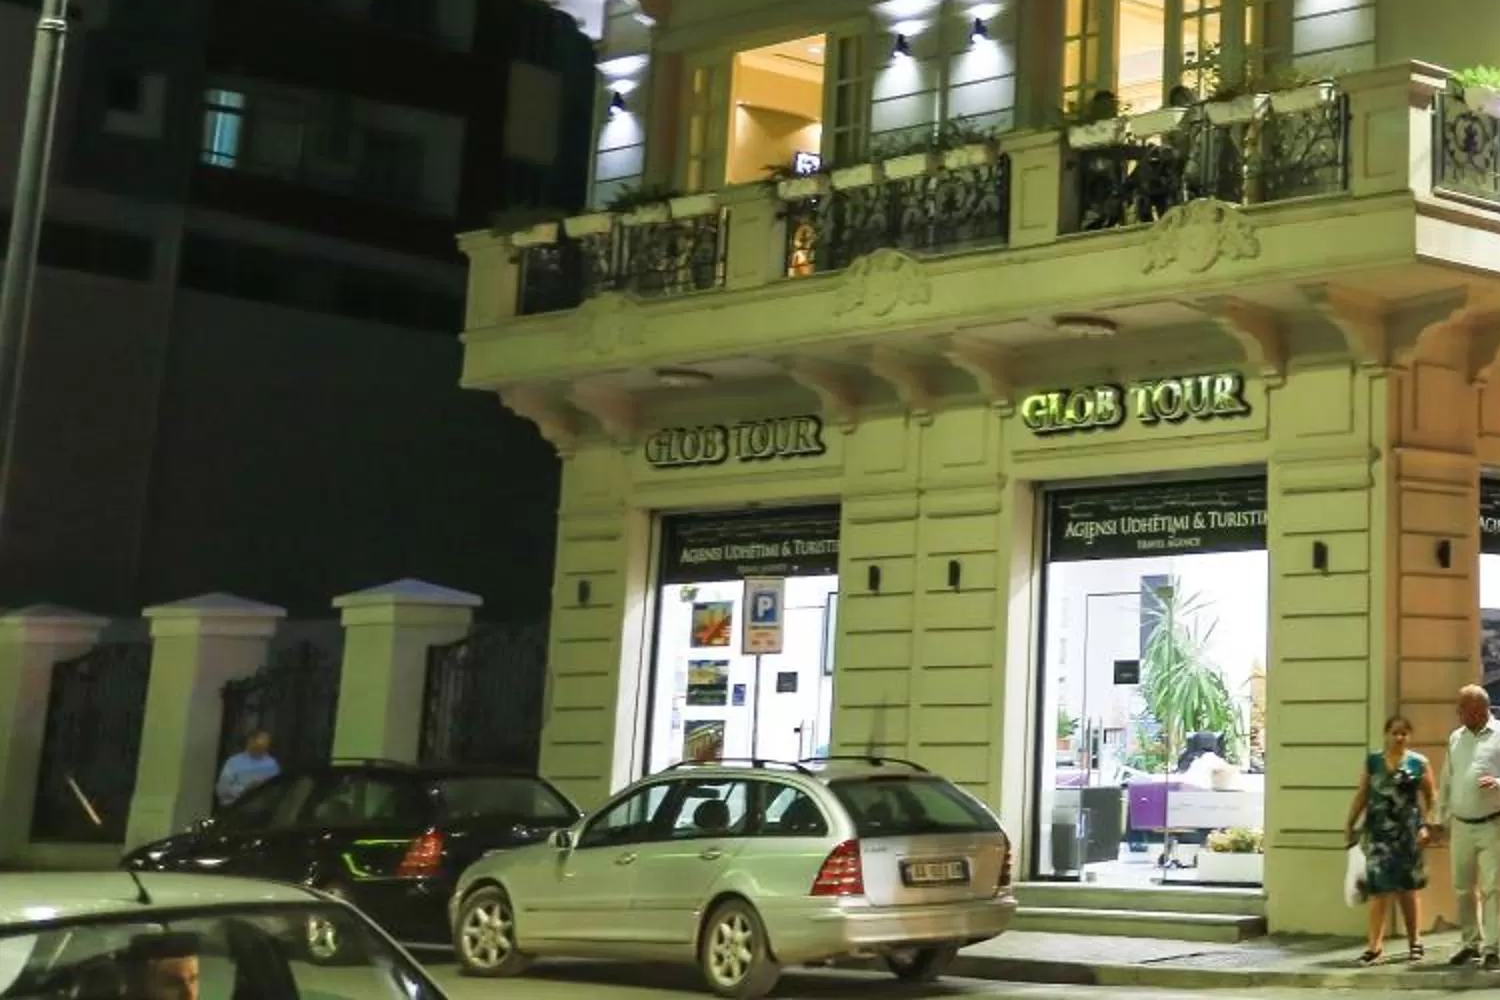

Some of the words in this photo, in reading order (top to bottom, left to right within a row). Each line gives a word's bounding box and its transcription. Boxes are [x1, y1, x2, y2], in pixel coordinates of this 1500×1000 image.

[1021, 385, 1126, 437] GLOB
[1130, 371, 1252, 426] TOUR
[646, 425, 729, 468] GLOB
[733, 414, 827, 462] TOUR
[1193, 512, 1206, 528] &
[757, 595, 773, 618] P
